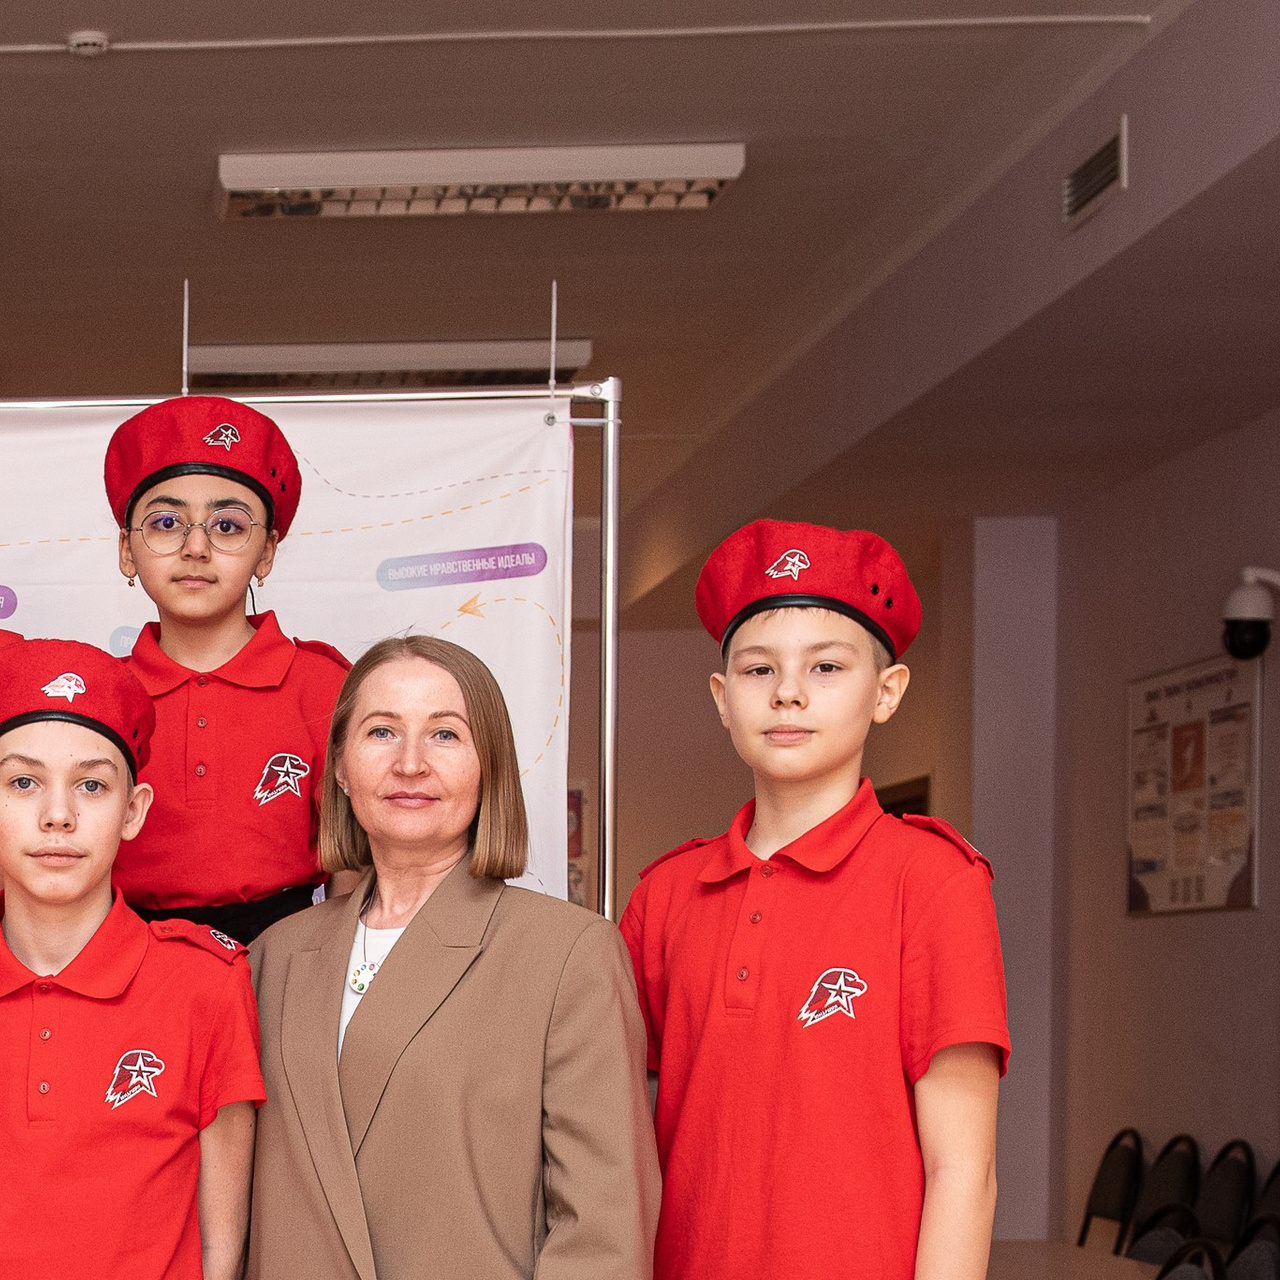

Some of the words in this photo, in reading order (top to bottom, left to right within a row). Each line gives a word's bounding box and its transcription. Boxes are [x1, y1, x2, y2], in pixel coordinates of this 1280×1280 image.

[388, 565, 429, 580] ВЫСОКИЕ
[430, 556, 497, 576] НРАВСТВЕННЫЕ
[498, 552, 536, 569] ИДЕАЛЫ
